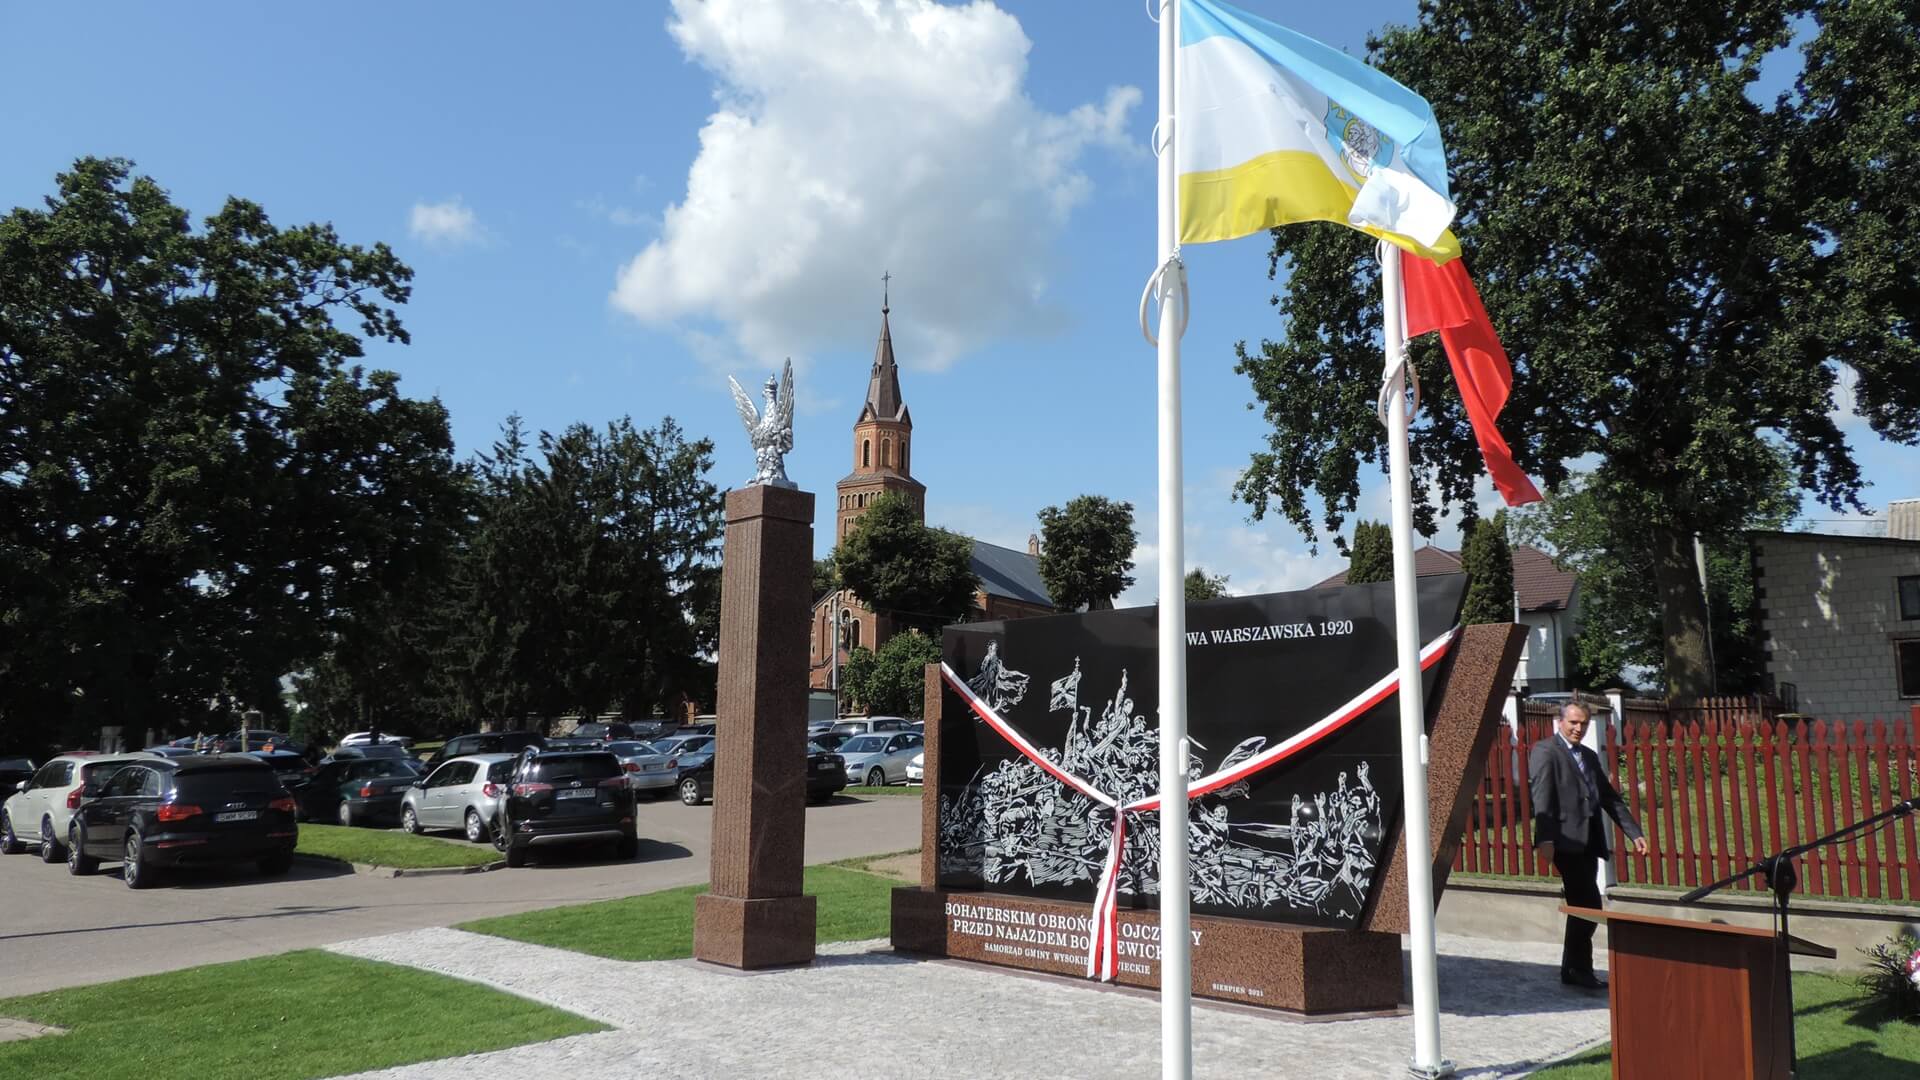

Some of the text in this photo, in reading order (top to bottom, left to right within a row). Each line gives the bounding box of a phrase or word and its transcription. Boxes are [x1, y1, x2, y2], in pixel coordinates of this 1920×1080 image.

[1186, 620, 1353, 646] WA WARSZAWSKA 1920
[944, 902, 1035, 926] BOHATERSKIM
[1122, 922, 1202, 946] OJCZY
[953, 919, 993, 937] PRZED
[996, 925, 1067, 947] NAJAZDEM
[984, 942, 1022, 957] SAMORZĄD
[1024, 947, 1050, 960] GMINY
